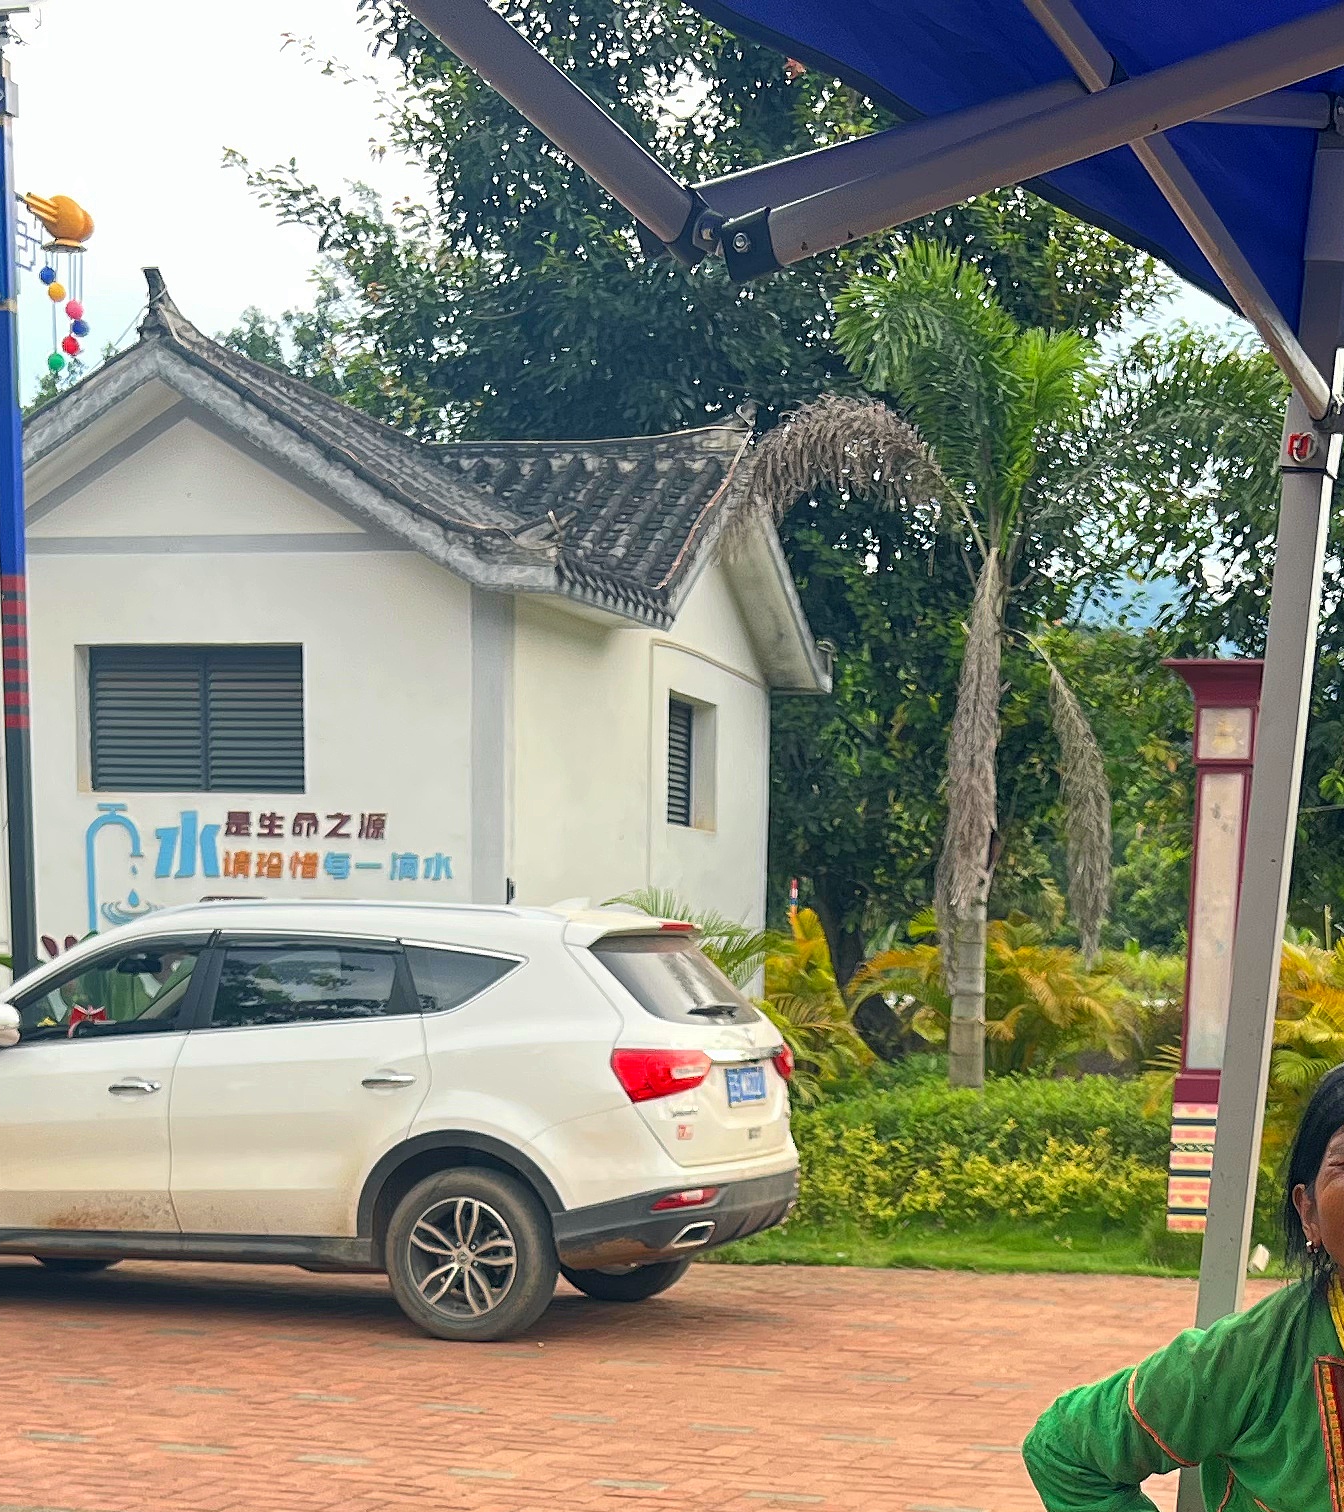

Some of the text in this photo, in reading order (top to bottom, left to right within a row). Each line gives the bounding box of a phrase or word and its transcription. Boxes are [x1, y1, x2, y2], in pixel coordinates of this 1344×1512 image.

[155, 810, 387, 879] 水 是生命之源
[223, 851, 453, 880] 请珍惜每一滴水
